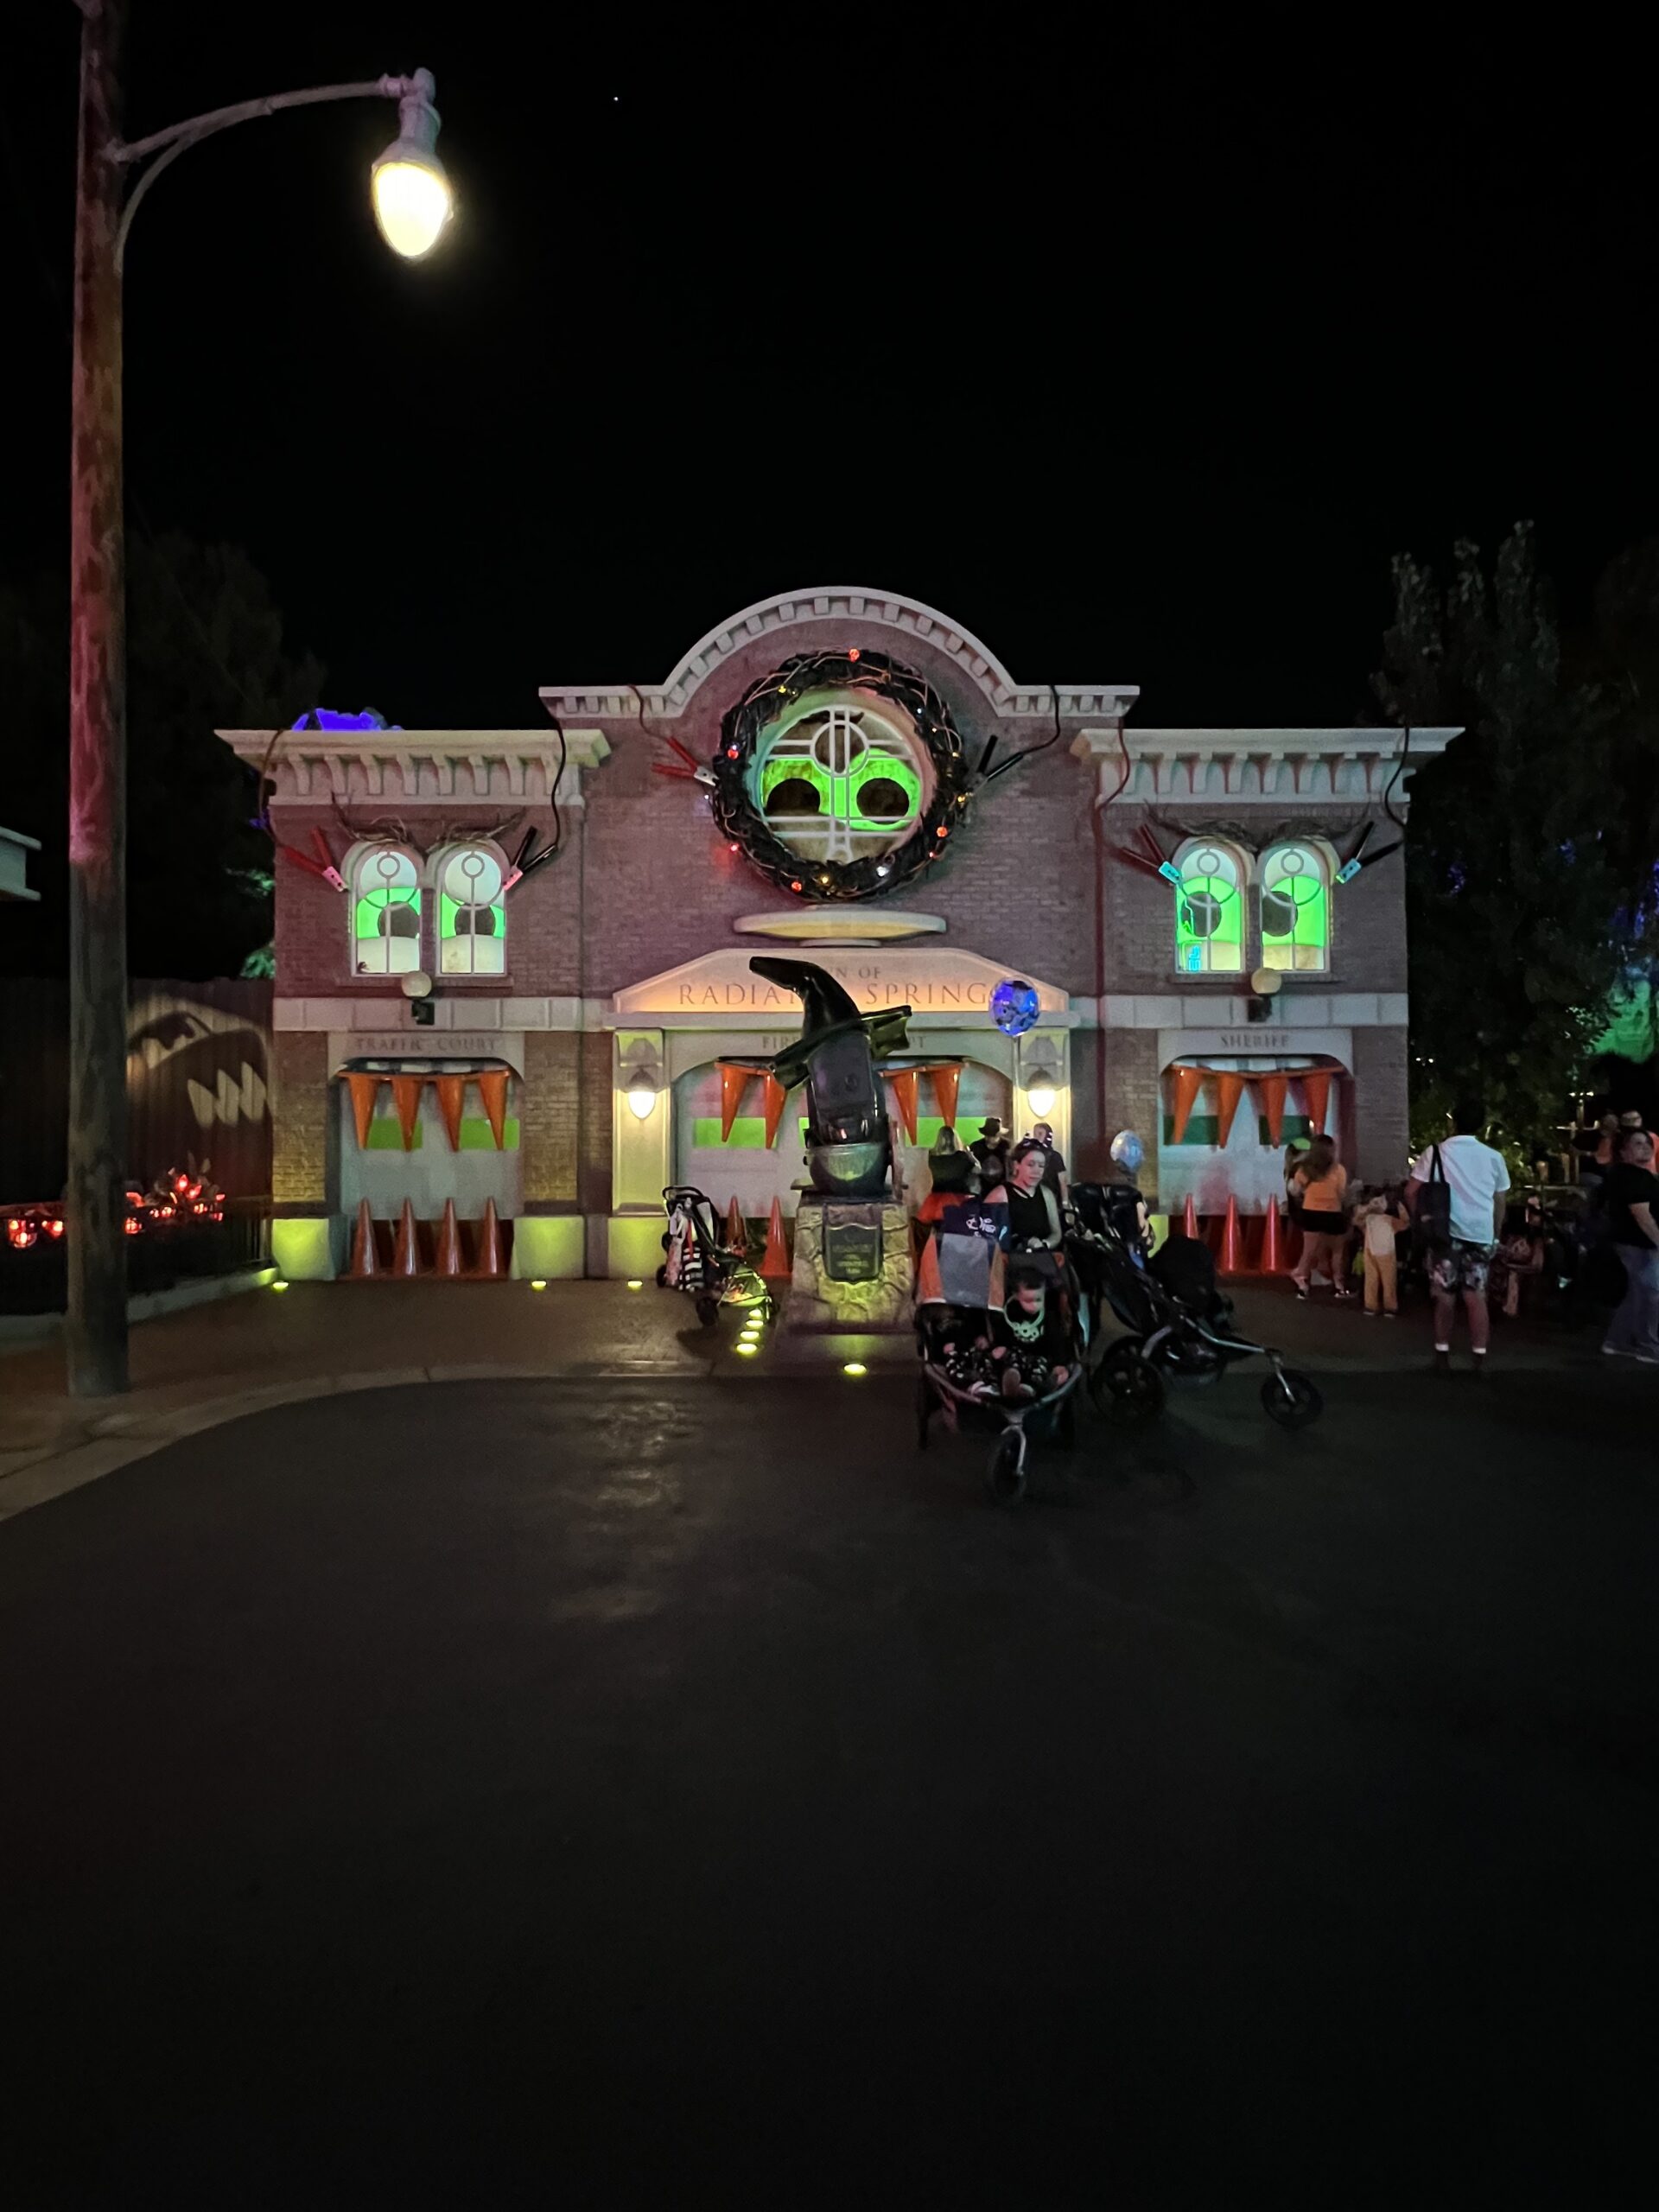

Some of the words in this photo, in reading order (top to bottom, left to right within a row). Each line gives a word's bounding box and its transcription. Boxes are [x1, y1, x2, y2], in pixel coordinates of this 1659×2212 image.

[858, 967, 881, 979] OF
[679, 984, 795, 1005] RADIA
[866, 982, 987, 1005] SPRING
[437, 1038, 495, 1052] COURT
[1220, 1033, 1288, 1048] SHERIFF
